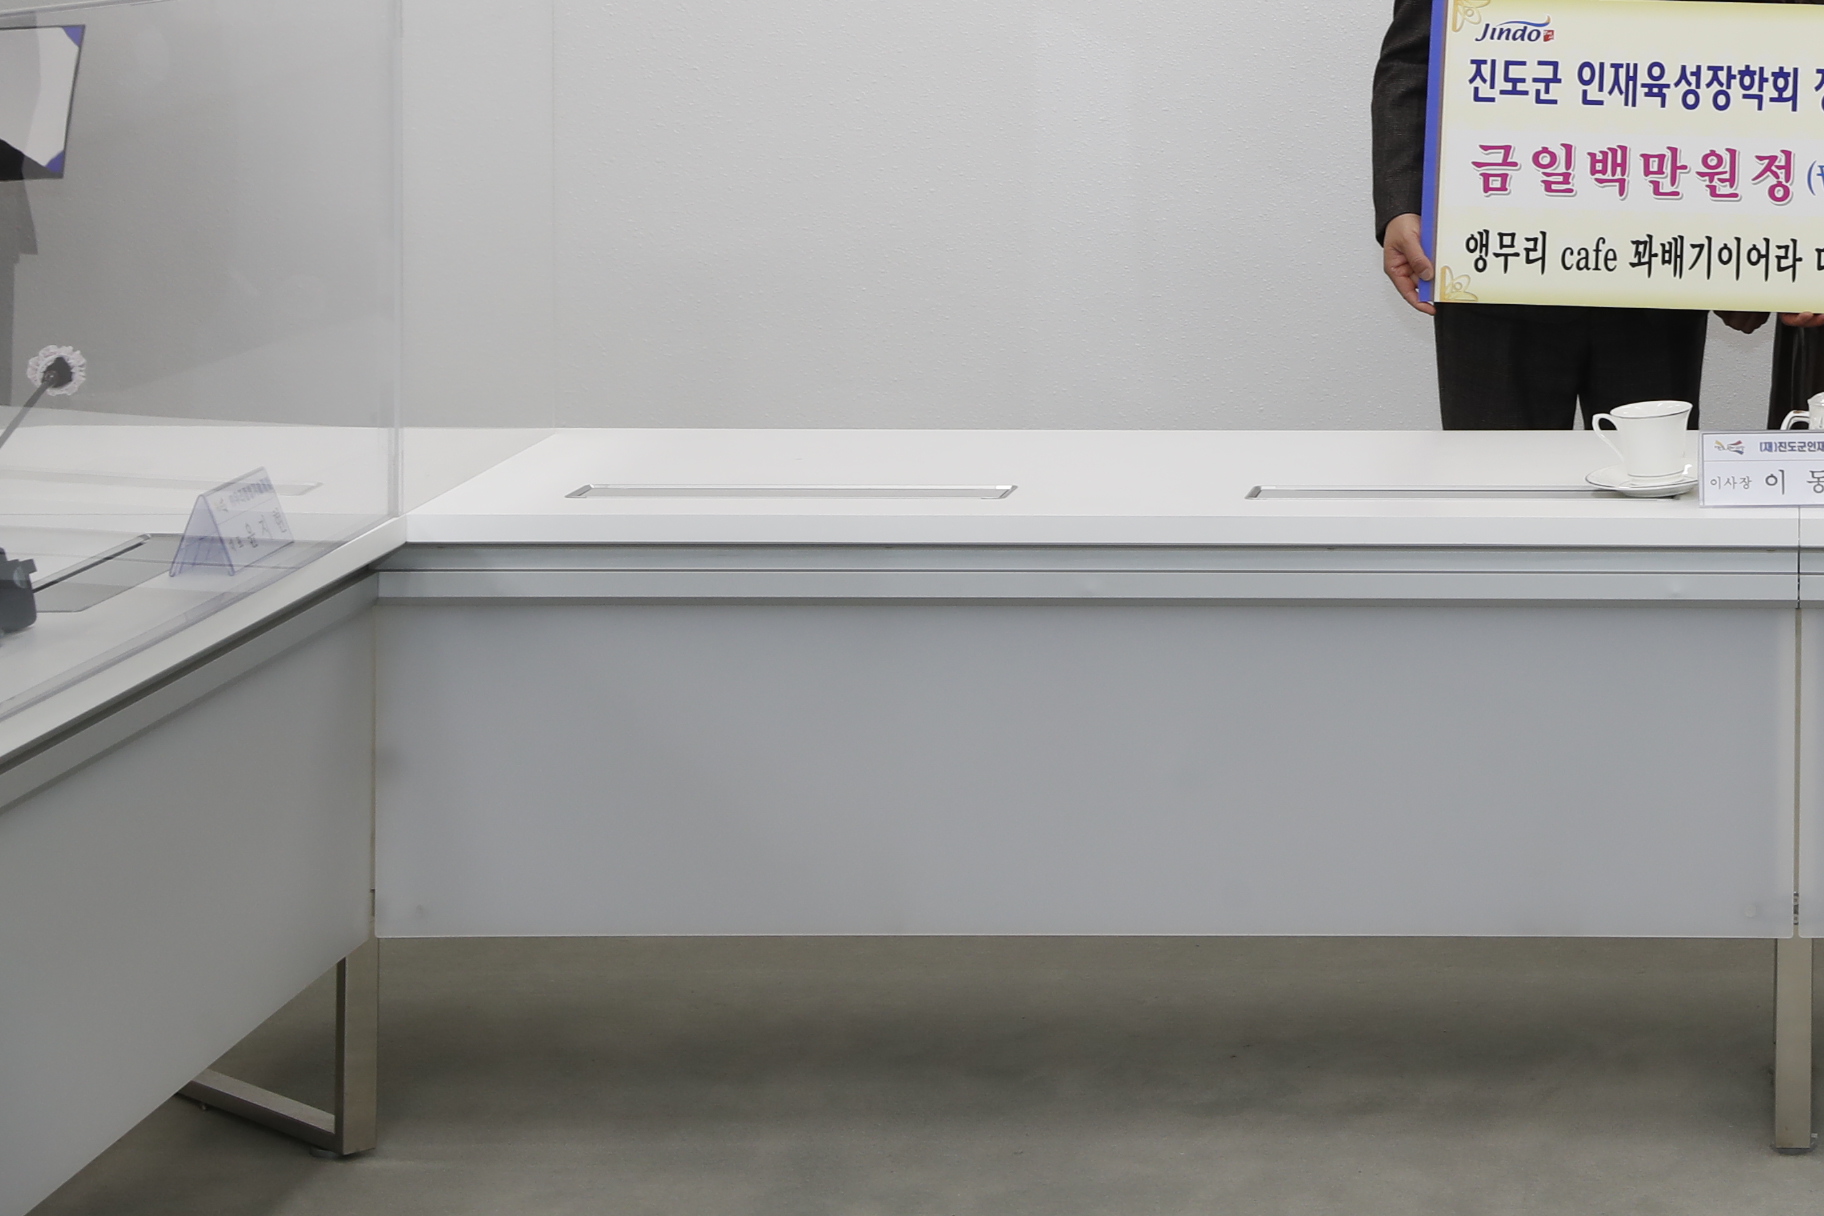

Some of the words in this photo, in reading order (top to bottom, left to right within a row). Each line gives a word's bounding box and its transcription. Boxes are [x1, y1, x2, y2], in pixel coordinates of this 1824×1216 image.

[1475, 23, 1541, 42] Jindo
[1467, 59, 1562, 105] 진도군
[1577, 62, 1800, 112] 인재육성장학회
[1464, 230, 1547, 276] 앵무리
[1561, 237, 1617, 273] cafe
[1629, 234, 1802, 282] 꽈배기이어라
[1710, 475, 1752, 490] 이사장
